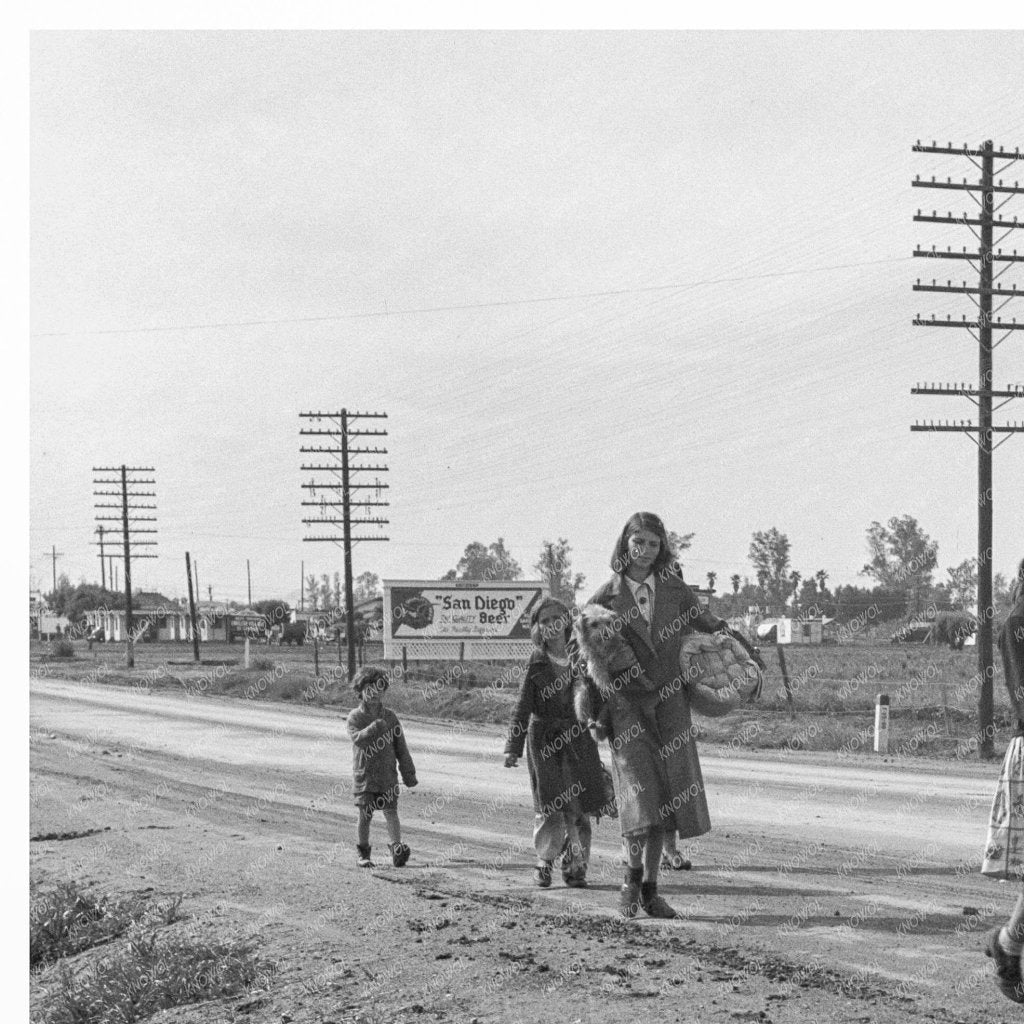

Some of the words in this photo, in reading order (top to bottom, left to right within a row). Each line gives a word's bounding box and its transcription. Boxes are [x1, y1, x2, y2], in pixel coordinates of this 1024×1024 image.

[435, 595, 471, 610] "San
[475, 595, 523, 614] Diego"
[479, 612, 510, 624] Beer
